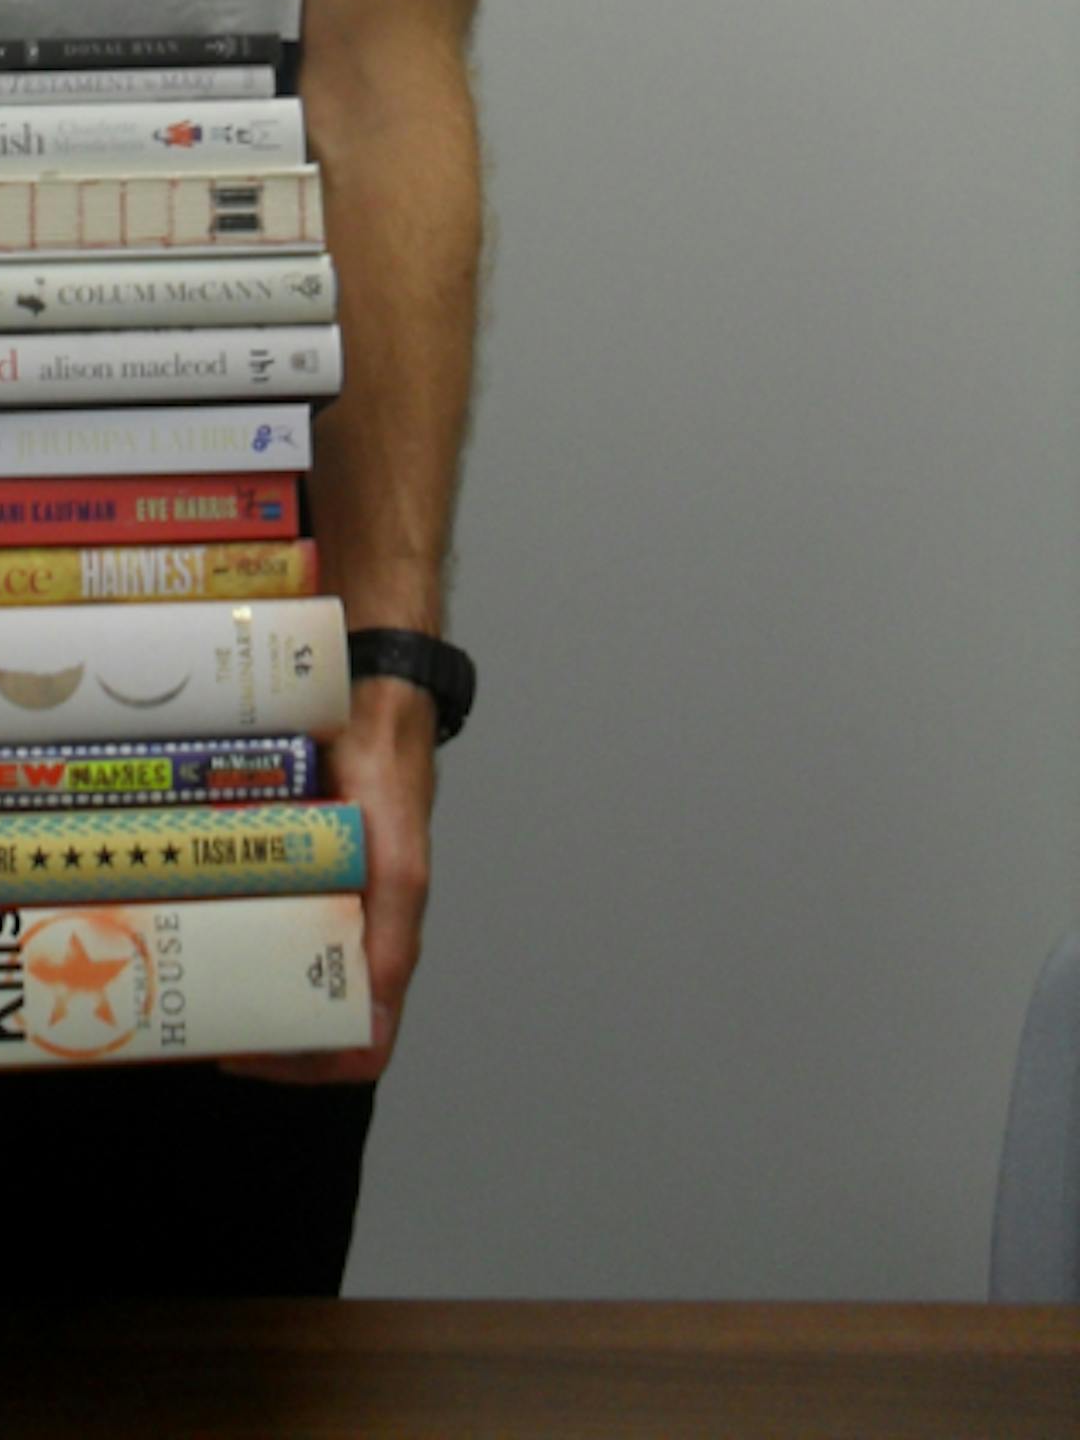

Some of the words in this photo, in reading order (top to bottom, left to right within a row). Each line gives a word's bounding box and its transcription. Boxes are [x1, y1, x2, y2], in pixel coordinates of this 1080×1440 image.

[57, 279, 157, 307] COLUM
[39, 355, 114, 382] alison
[121, 351, 229, 380] macleod
[135, 496, 169, 522] EVE
[80, 545, 207, 597] HARVEST
[191, 835, 237, 865] TASH
[154, 912, 188, 1047] HOUSE
